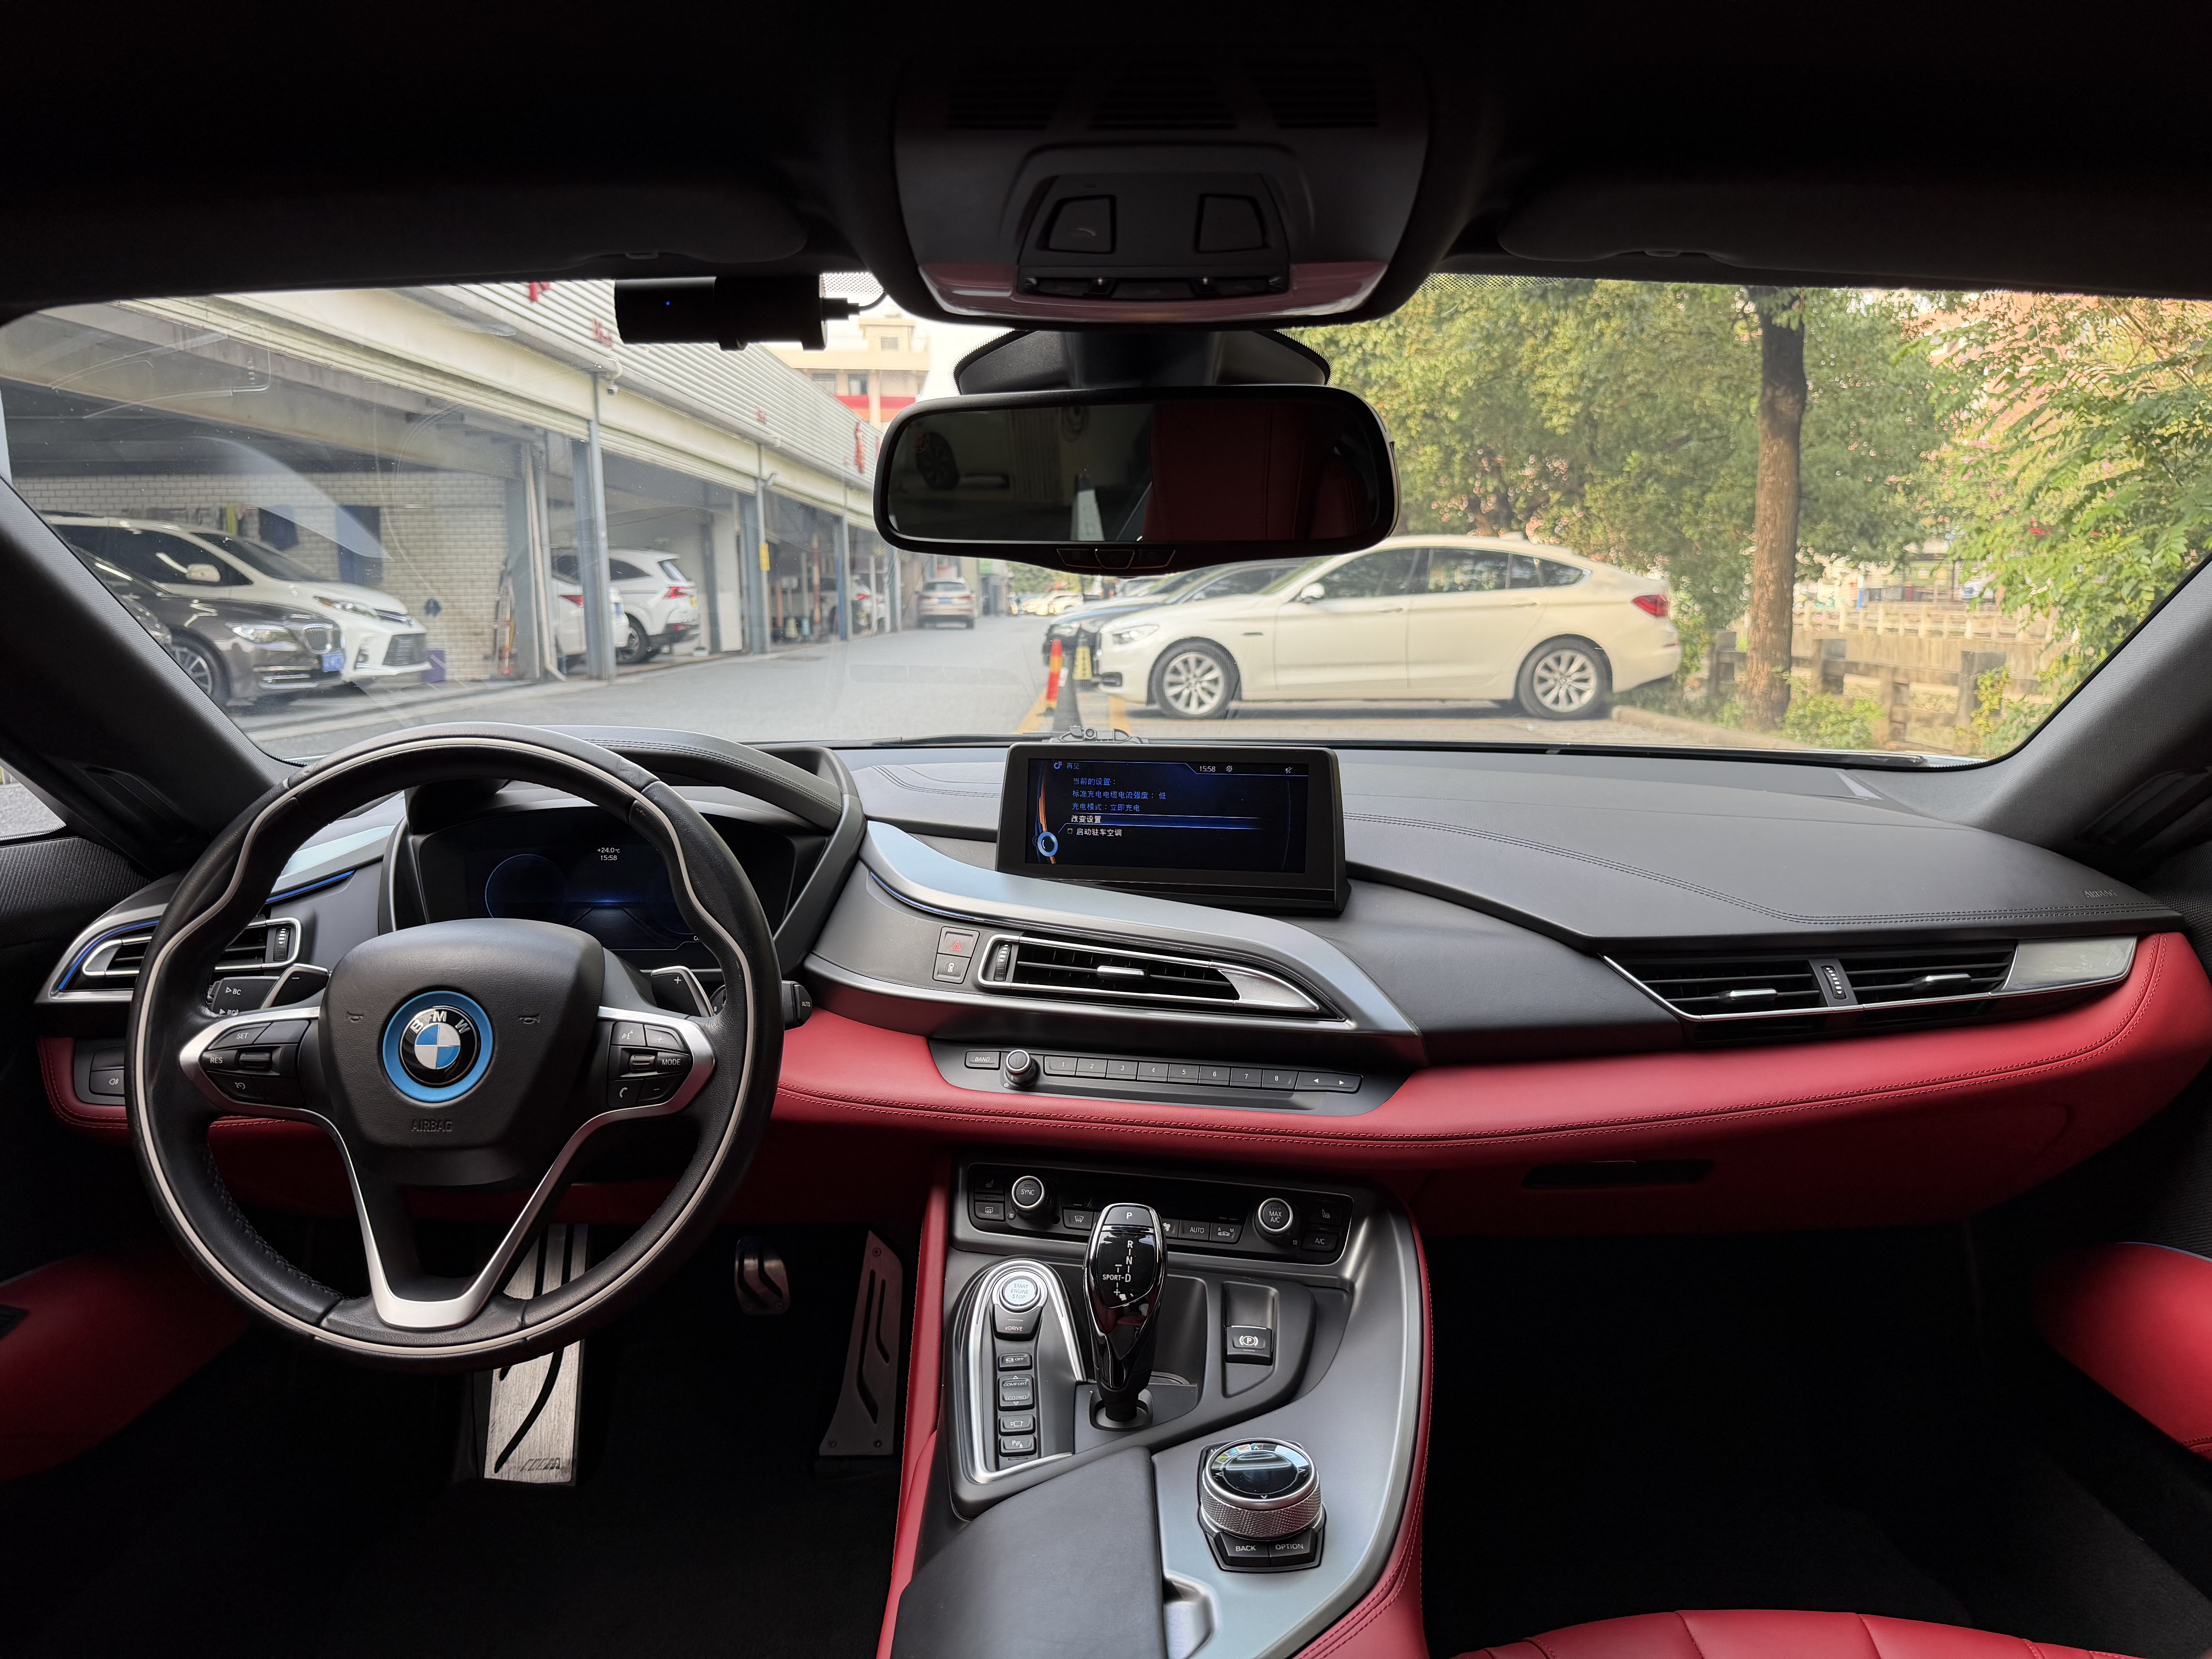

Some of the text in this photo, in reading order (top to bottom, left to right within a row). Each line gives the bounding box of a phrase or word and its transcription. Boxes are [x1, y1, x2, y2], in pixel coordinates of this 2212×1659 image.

[1071, 815, 1101, 823] 改变设置
[1076, 828, 1122, 837] 启动驻车空调
[410, 1011, 471, 1034] BMW
[412, 1120, 453, 1132] AIRBAG
[1126, 1256, 1132, 1265] N
